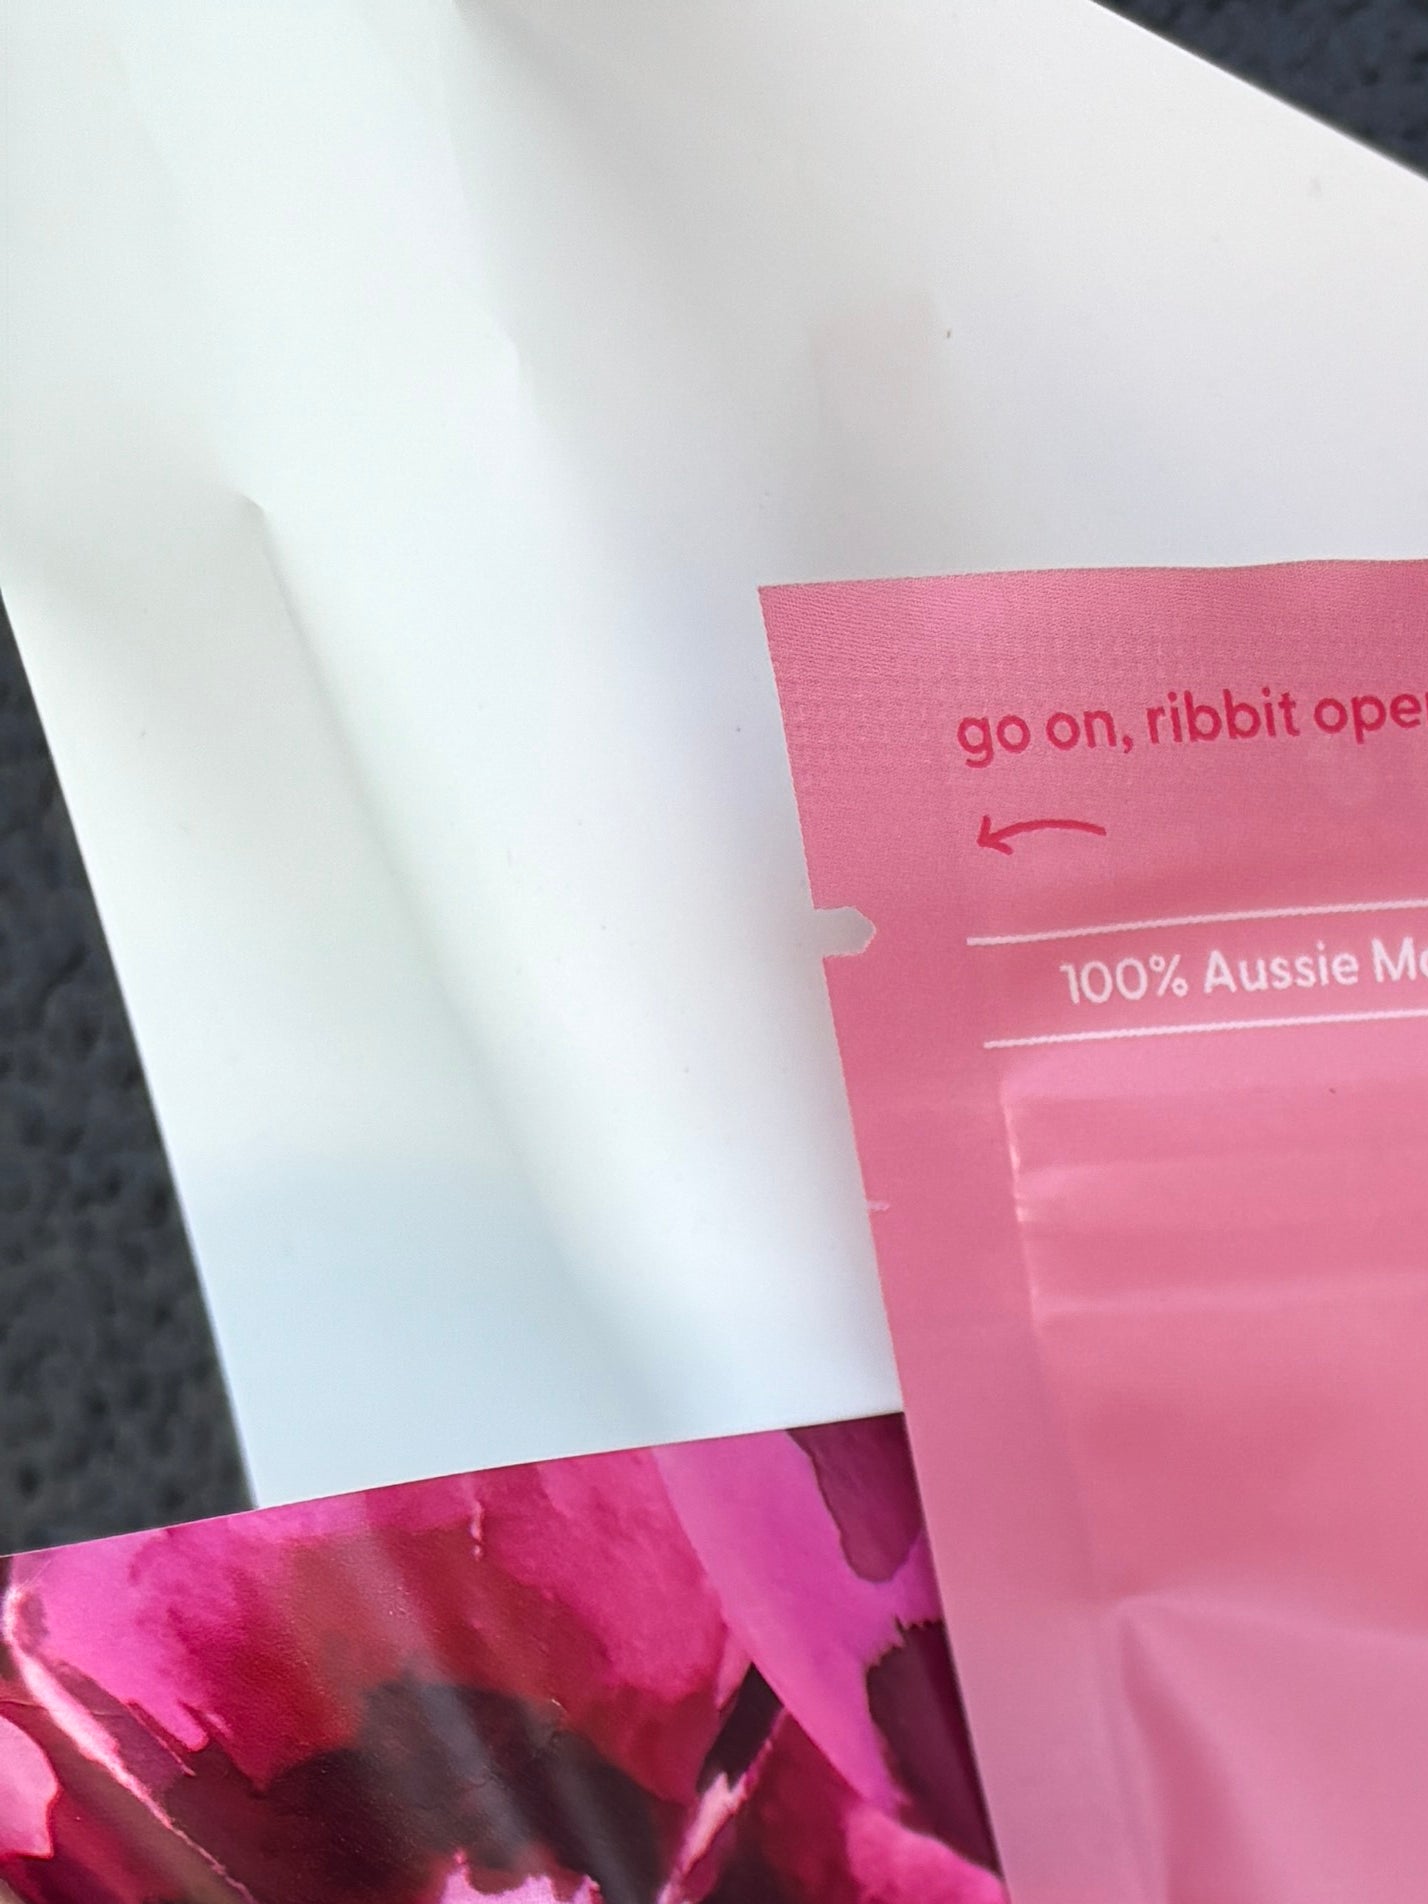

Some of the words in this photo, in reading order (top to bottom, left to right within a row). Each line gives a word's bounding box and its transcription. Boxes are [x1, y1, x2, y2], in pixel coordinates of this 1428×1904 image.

[957, 711, 1030, 768] go
[1047, 703, 1134, 754] on,
[1146, 688, 1299, 745] ribbit
[1060, 954, 1189, 1004] 100%
[1203, 945, 1359, 994] Aussie
